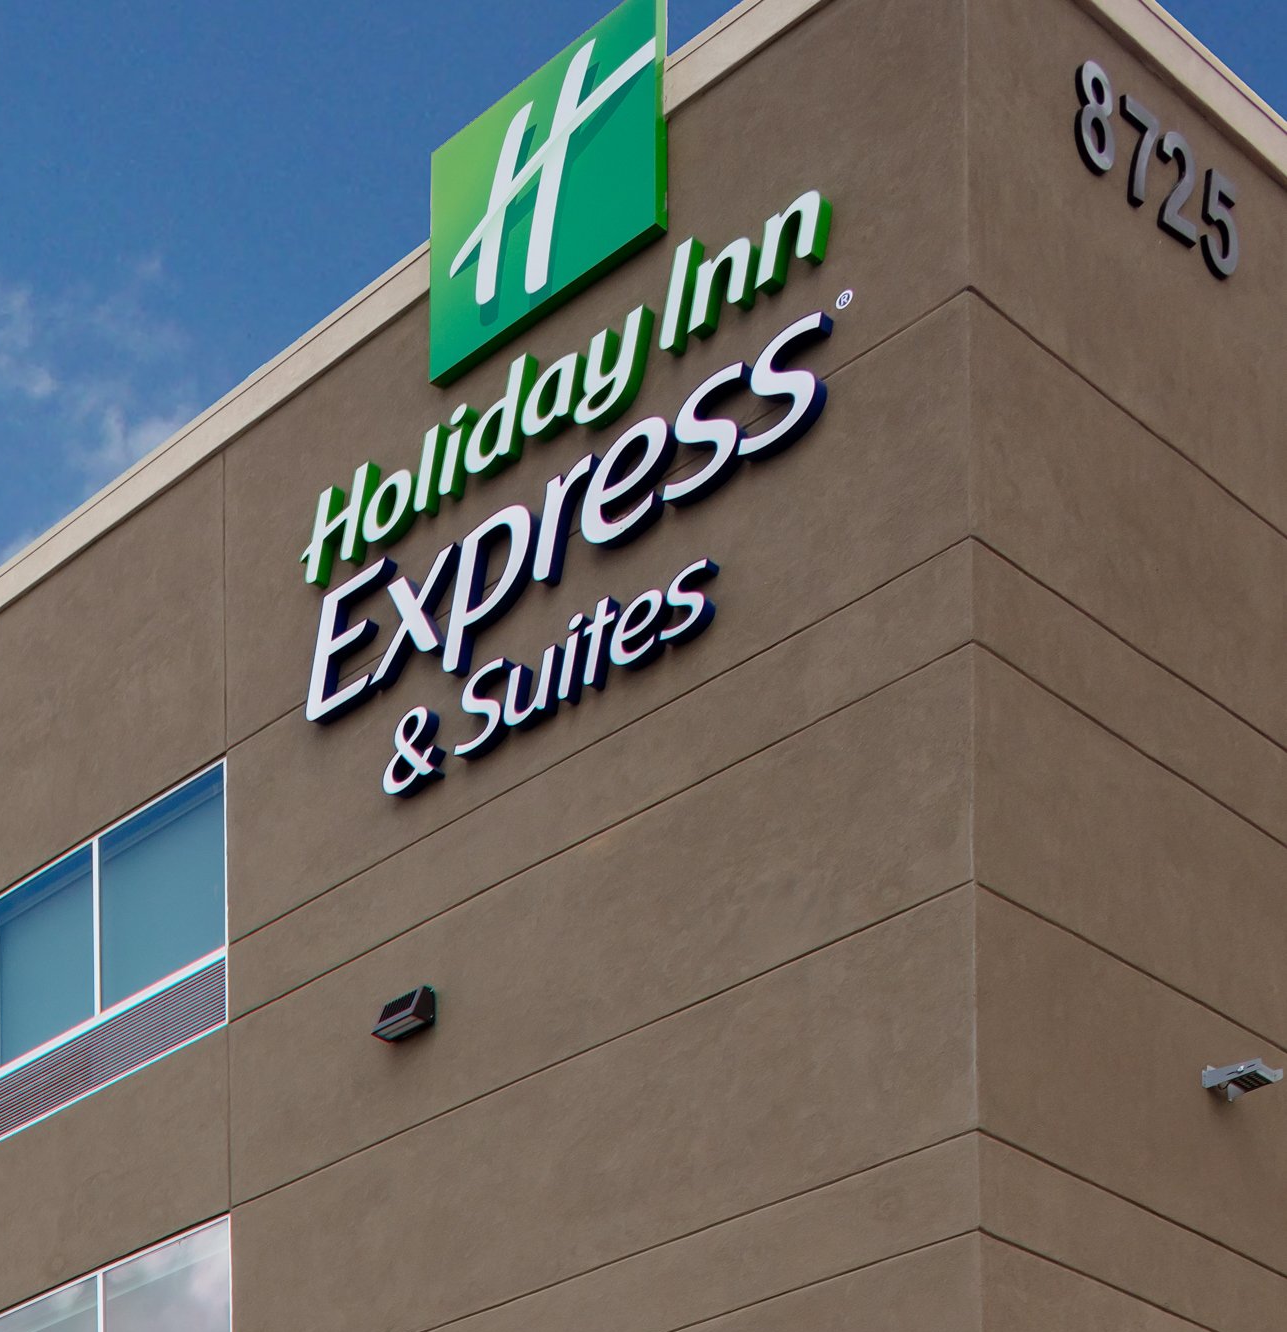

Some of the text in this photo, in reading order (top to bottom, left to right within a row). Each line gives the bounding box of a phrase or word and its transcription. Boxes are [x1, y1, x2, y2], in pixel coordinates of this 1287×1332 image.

[1074, 59, 1241, 280] 8725
[301, 189, 833, 588] Holiday Inn
[304, 310, 833, 723] Express
[382, 557, 719, 798] & Suites
